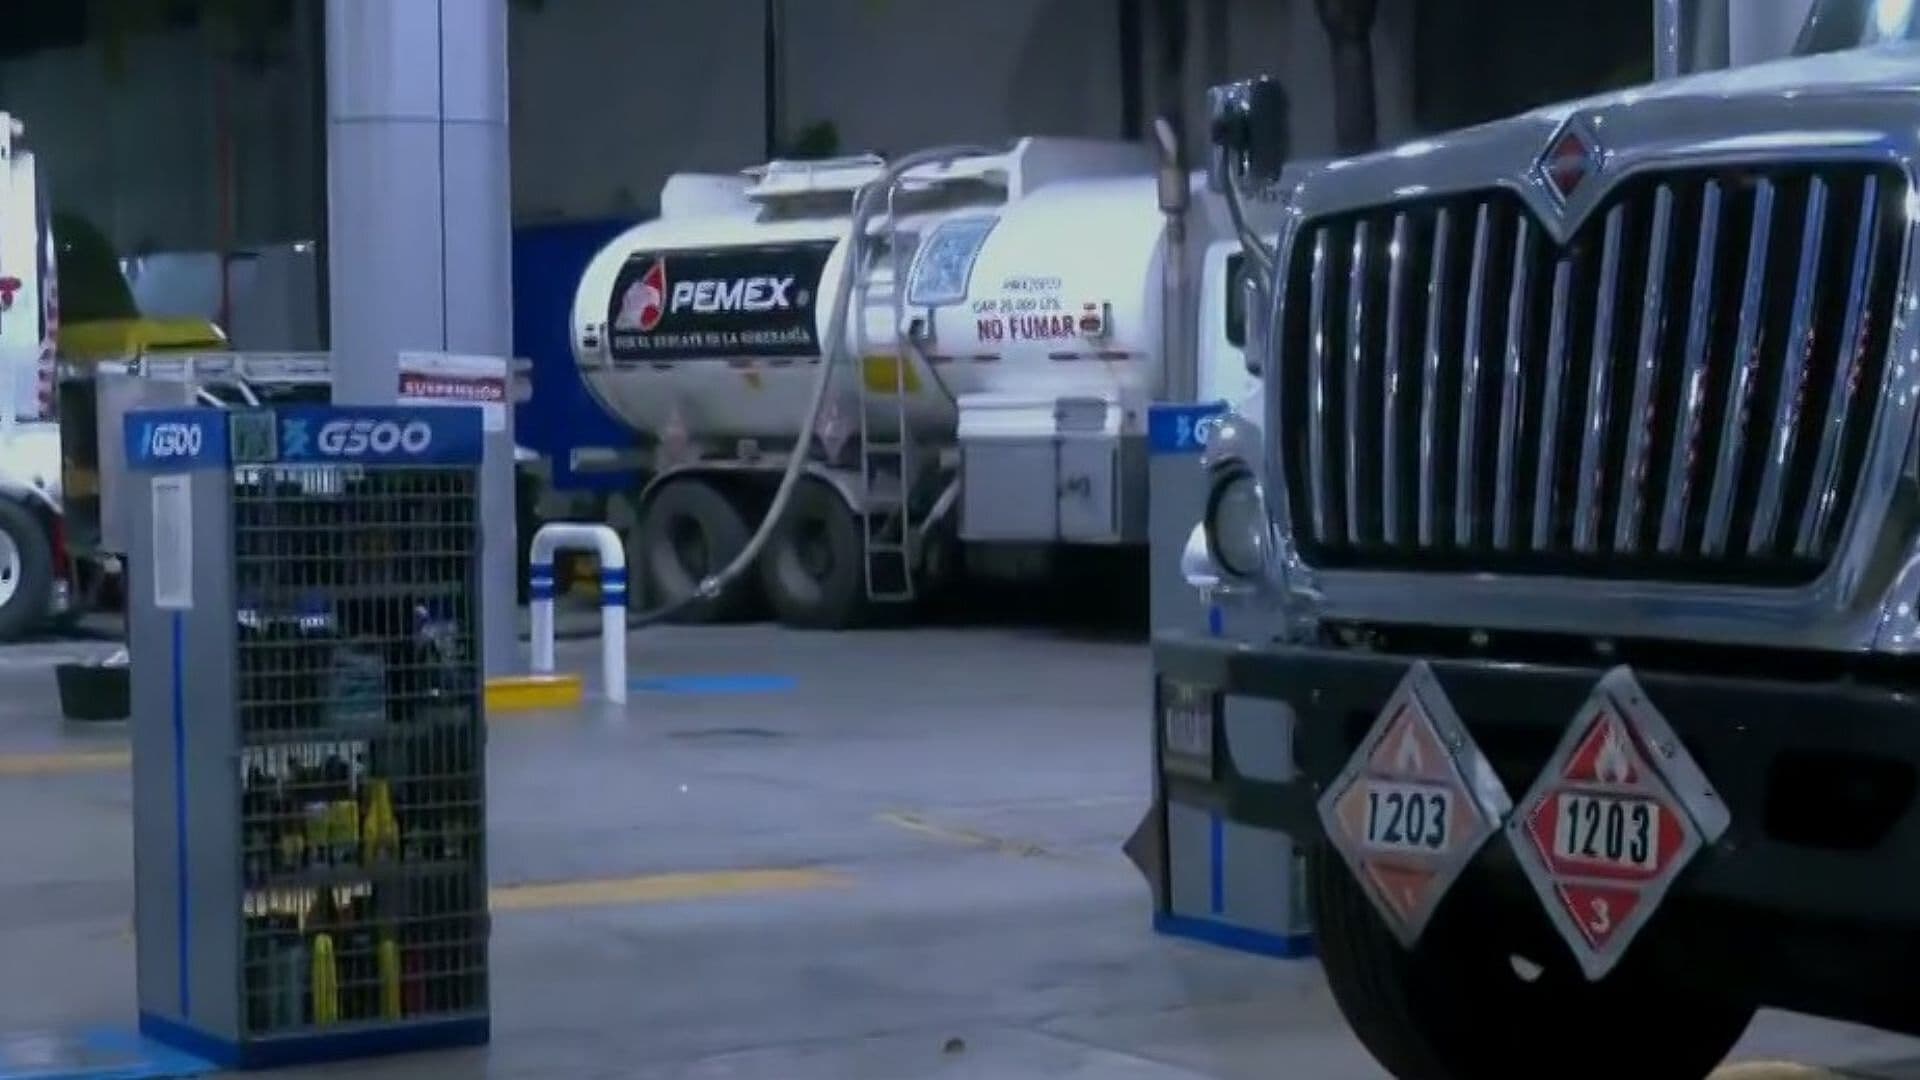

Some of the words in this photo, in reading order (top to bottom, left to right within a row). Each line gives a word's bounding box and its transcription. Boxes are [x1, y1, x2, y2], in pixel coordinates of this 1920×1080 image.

[672, 277, 795, 313] PEMEX
[977, 319, 1003, 340] NO
[1008, 314, 1075, 339] FUMAR
[318, 421, 432, 453] G500
[1368, 791, 1448, 850] 1203
[1567, 800, 1651, 864] 1203
[1589, 897, 1611, 934] 3
